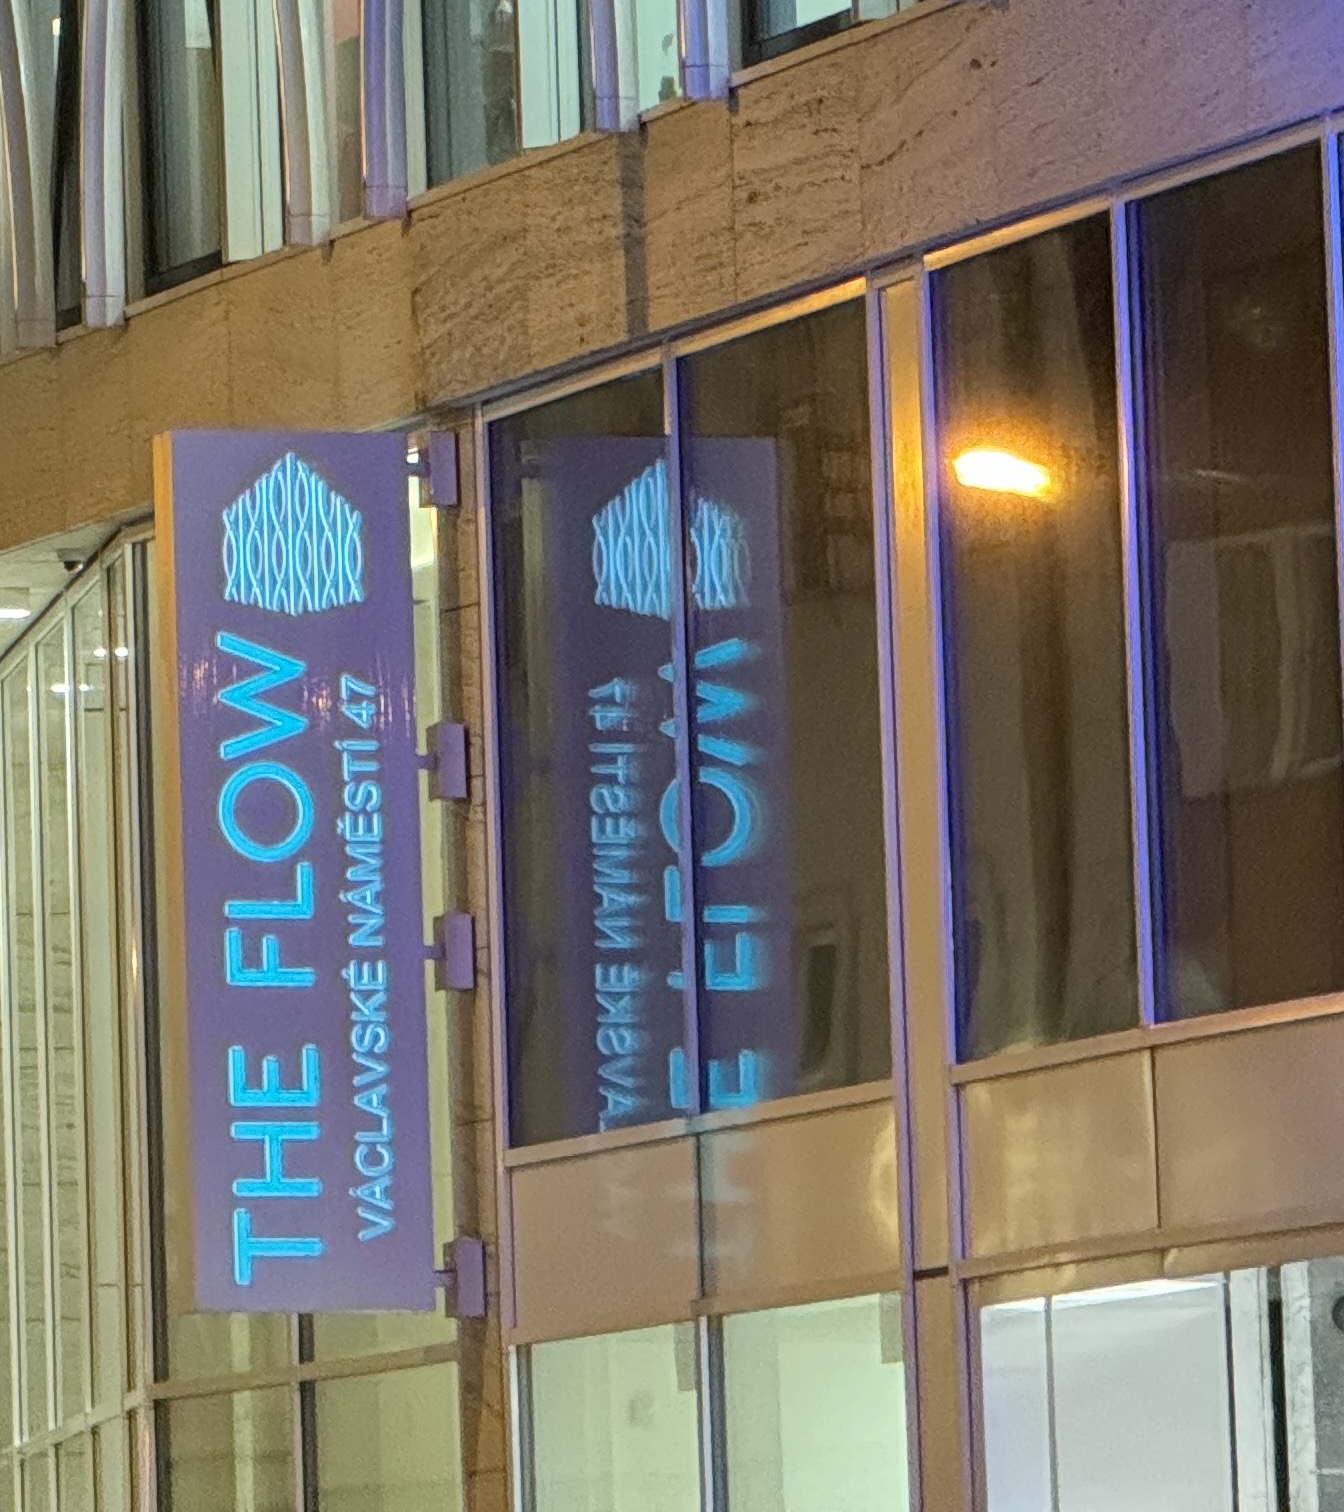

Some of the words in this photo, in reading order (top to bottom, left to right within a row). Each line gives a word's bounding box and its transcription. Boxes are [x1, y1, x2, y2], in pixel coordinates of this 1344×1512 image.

[216, 631, 315, 987] FLOW
[340, 673, 377, 729] 47
[333, 739, 387, 948] NÁMĚSTÍ
[228, 1043, 324, 1287] THE
[341, 959, 396, 1241] VÁCLAVSKÉ
